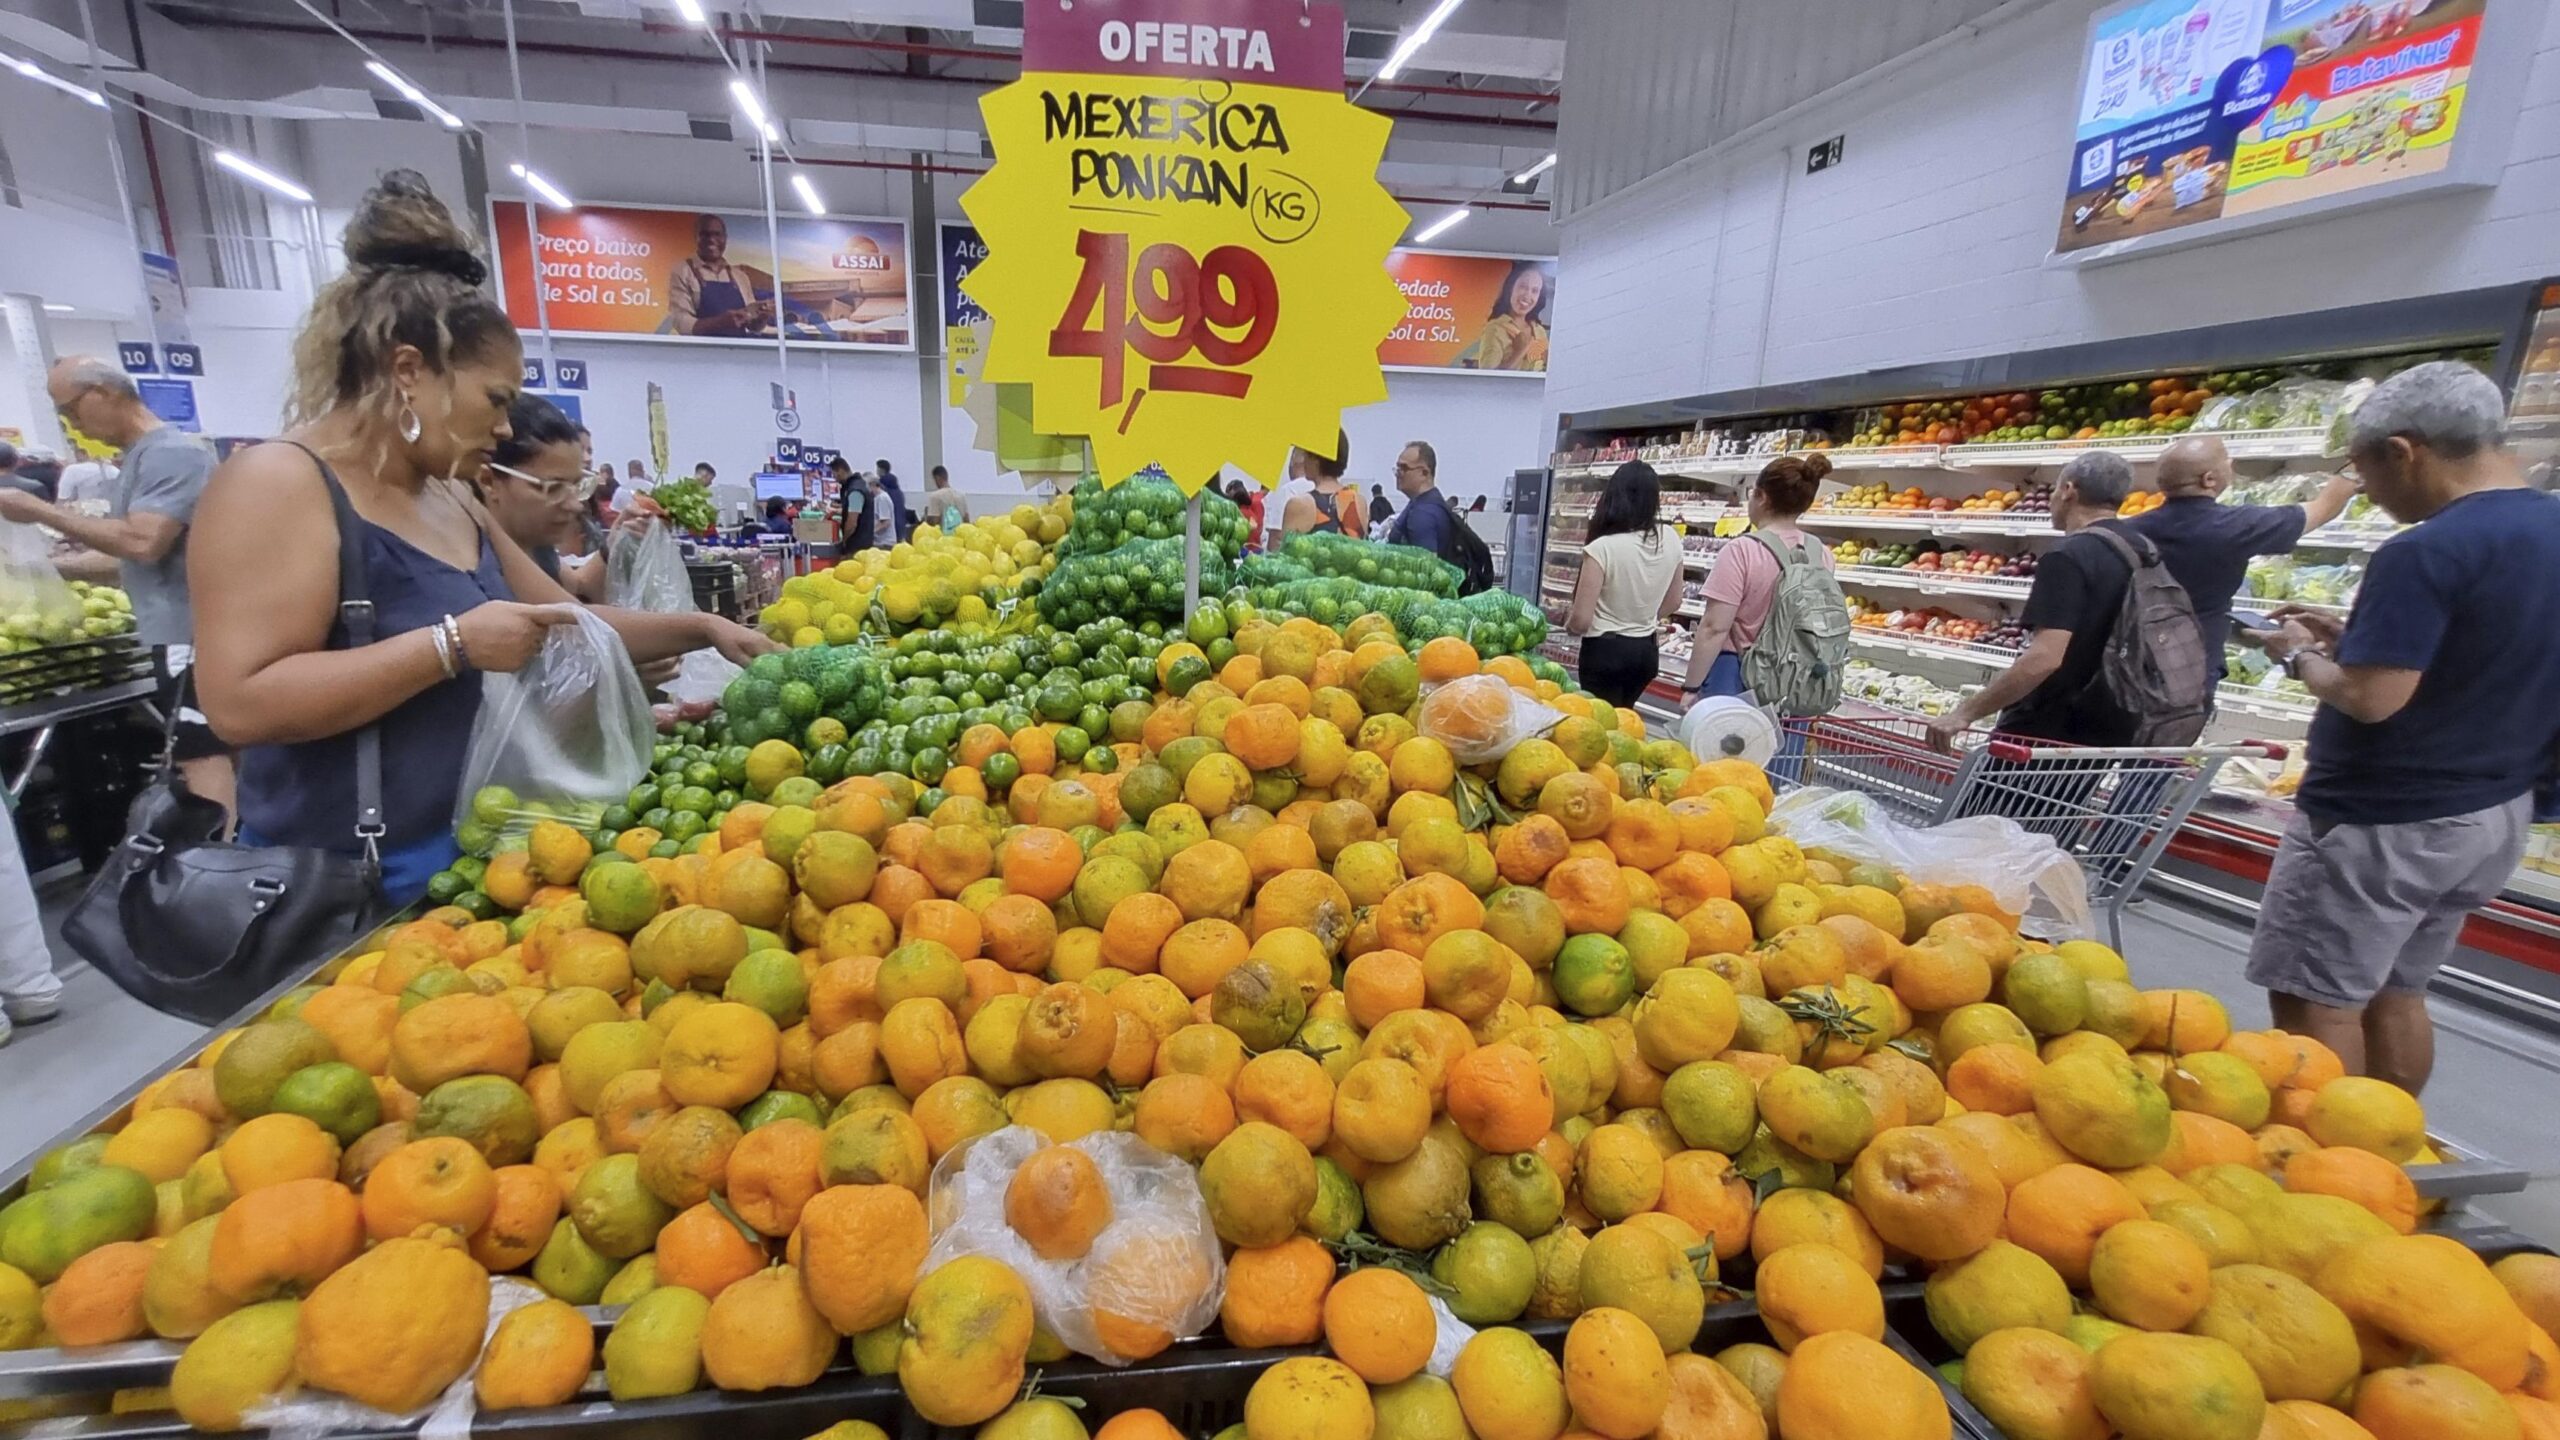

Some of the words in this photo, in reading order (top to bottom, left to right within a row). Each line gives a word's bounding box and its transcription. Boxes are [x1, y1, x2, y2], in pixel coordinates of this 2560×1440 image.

[1099, 20, 1275, 72] OFERTA
[1040, 80, 1290, 155] MEXERICA
[1071, 148, 1248, 209] PONKAN
[1264, 188, 1306, 221] KG
[594, 235, 651, 257] baixo
[955, 240, 988, 258] Ate
[586, 261, 648, 284] todos,
[567, 284, 598, 304] Sol
[602, 290, 616, 305] a
[621, 287, 660, 307] Sol.
[1415, 328, 1427, 341] a
[1430, 325, 1460, 342] Sol.
[124, 350, 146, 366] 10
[171, 352, 194, 368] 09
[560, 368, 580, 381] 07
[780, 444, 798, 457] 04
[804, 452, 820, 464] 05
